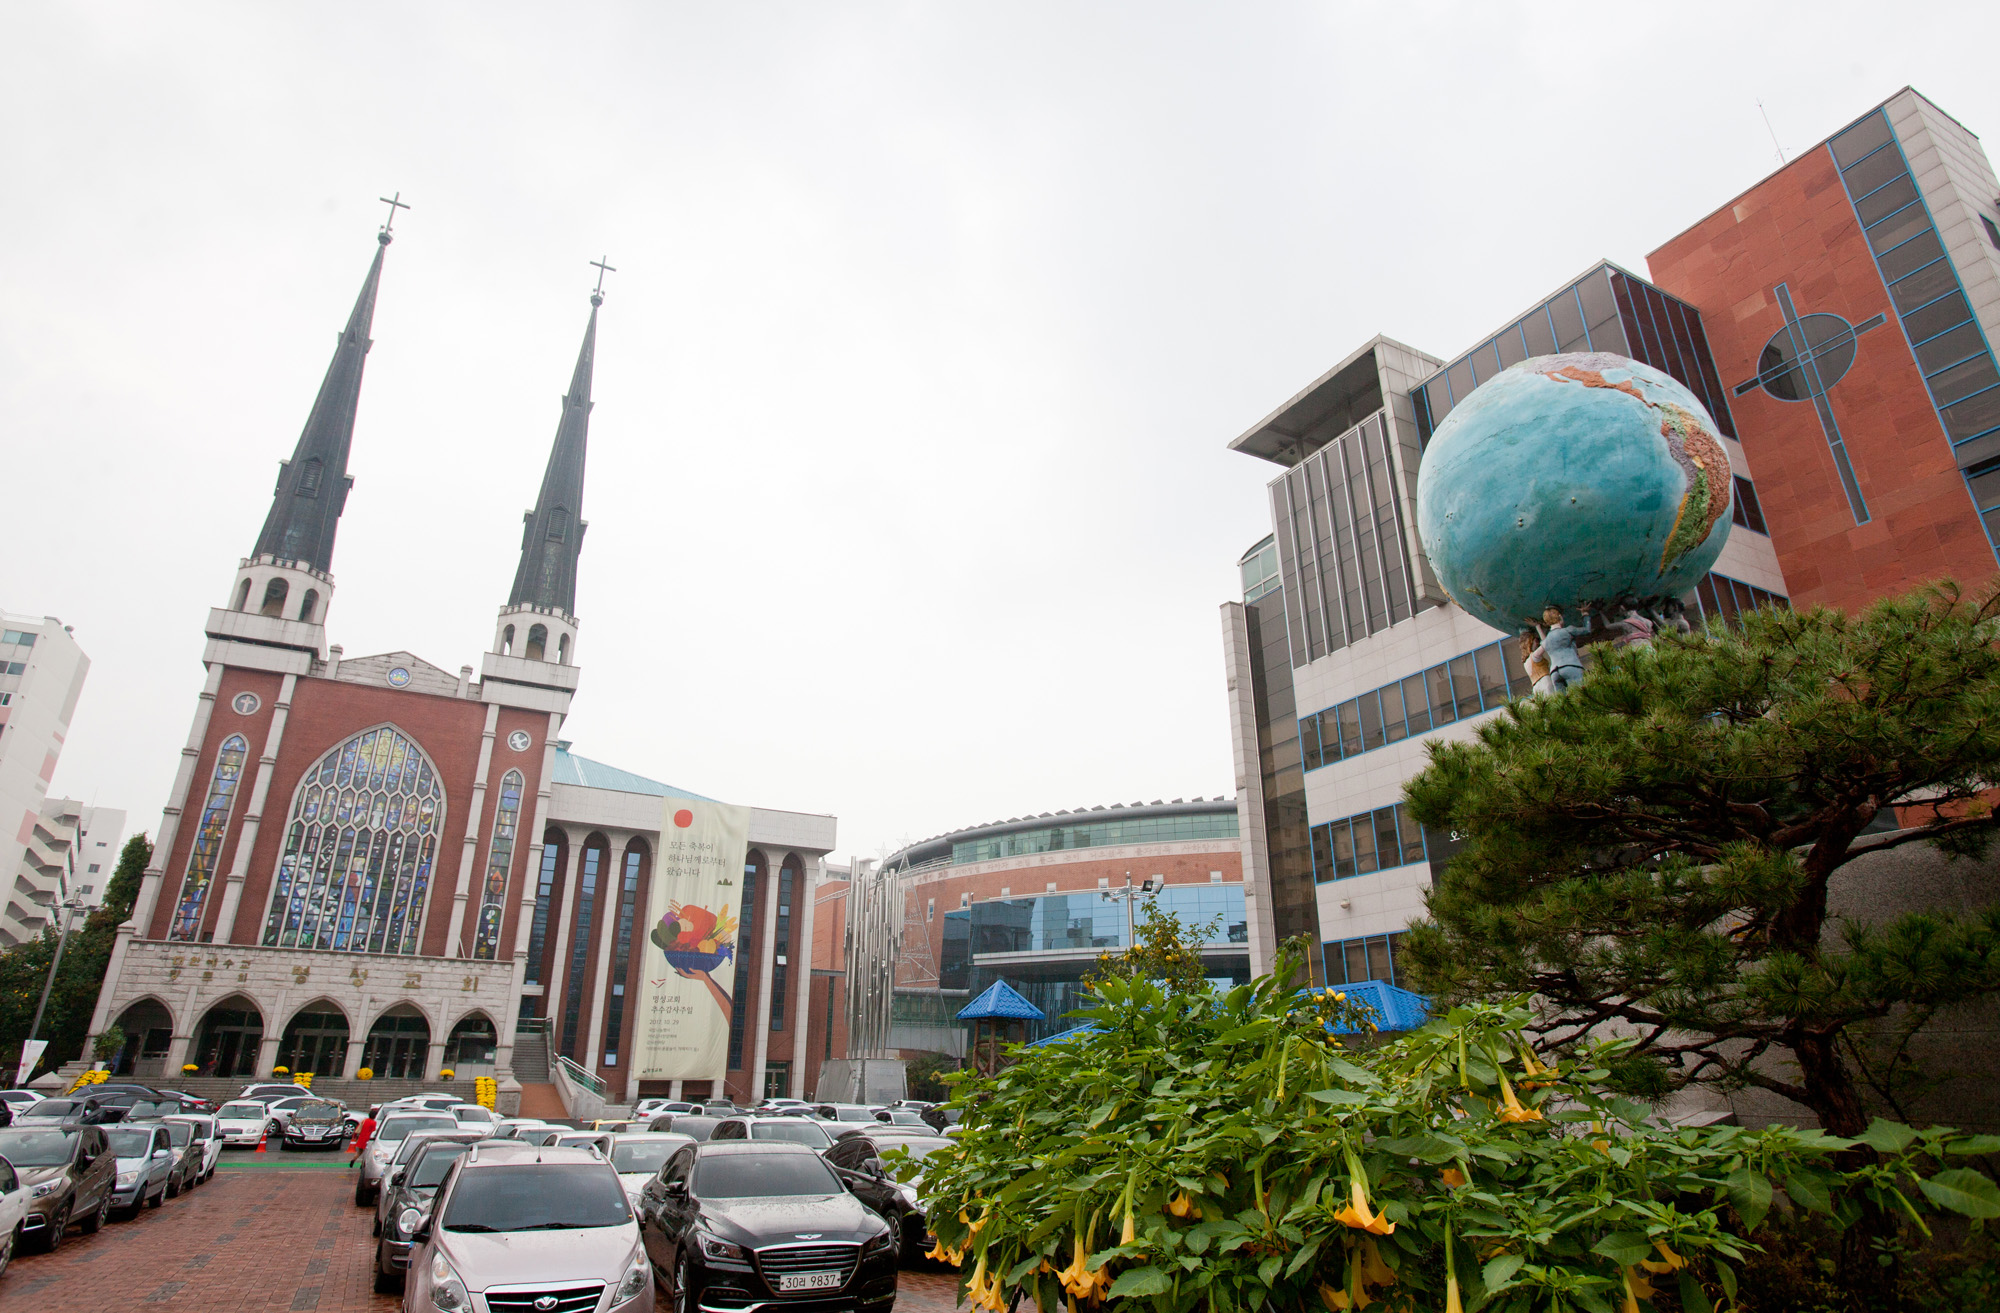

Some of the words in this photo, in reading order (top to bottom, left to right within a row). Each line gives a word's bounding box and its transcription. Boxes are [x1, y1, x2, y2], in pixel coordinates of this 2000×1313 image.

[669, 841, 686, 850] 모든
[689, 841, 714, 852] 축복이
[668, 854, 726, 867] 하나님께로부터
[666, 867, 700, 877] 왔습니다
[172, 956, 251, 970] 대한예수교
[169, 969, 248, 983] 장로회
[292, 965, 479, 993] 명성교회
[652, 995, 681, 1004] 명성교회
[651, 1005, 693, 1015] 추수감사주일
[785, 1277, 806, 1289] 30러
[810, 1274, 836, 1287] 9837
